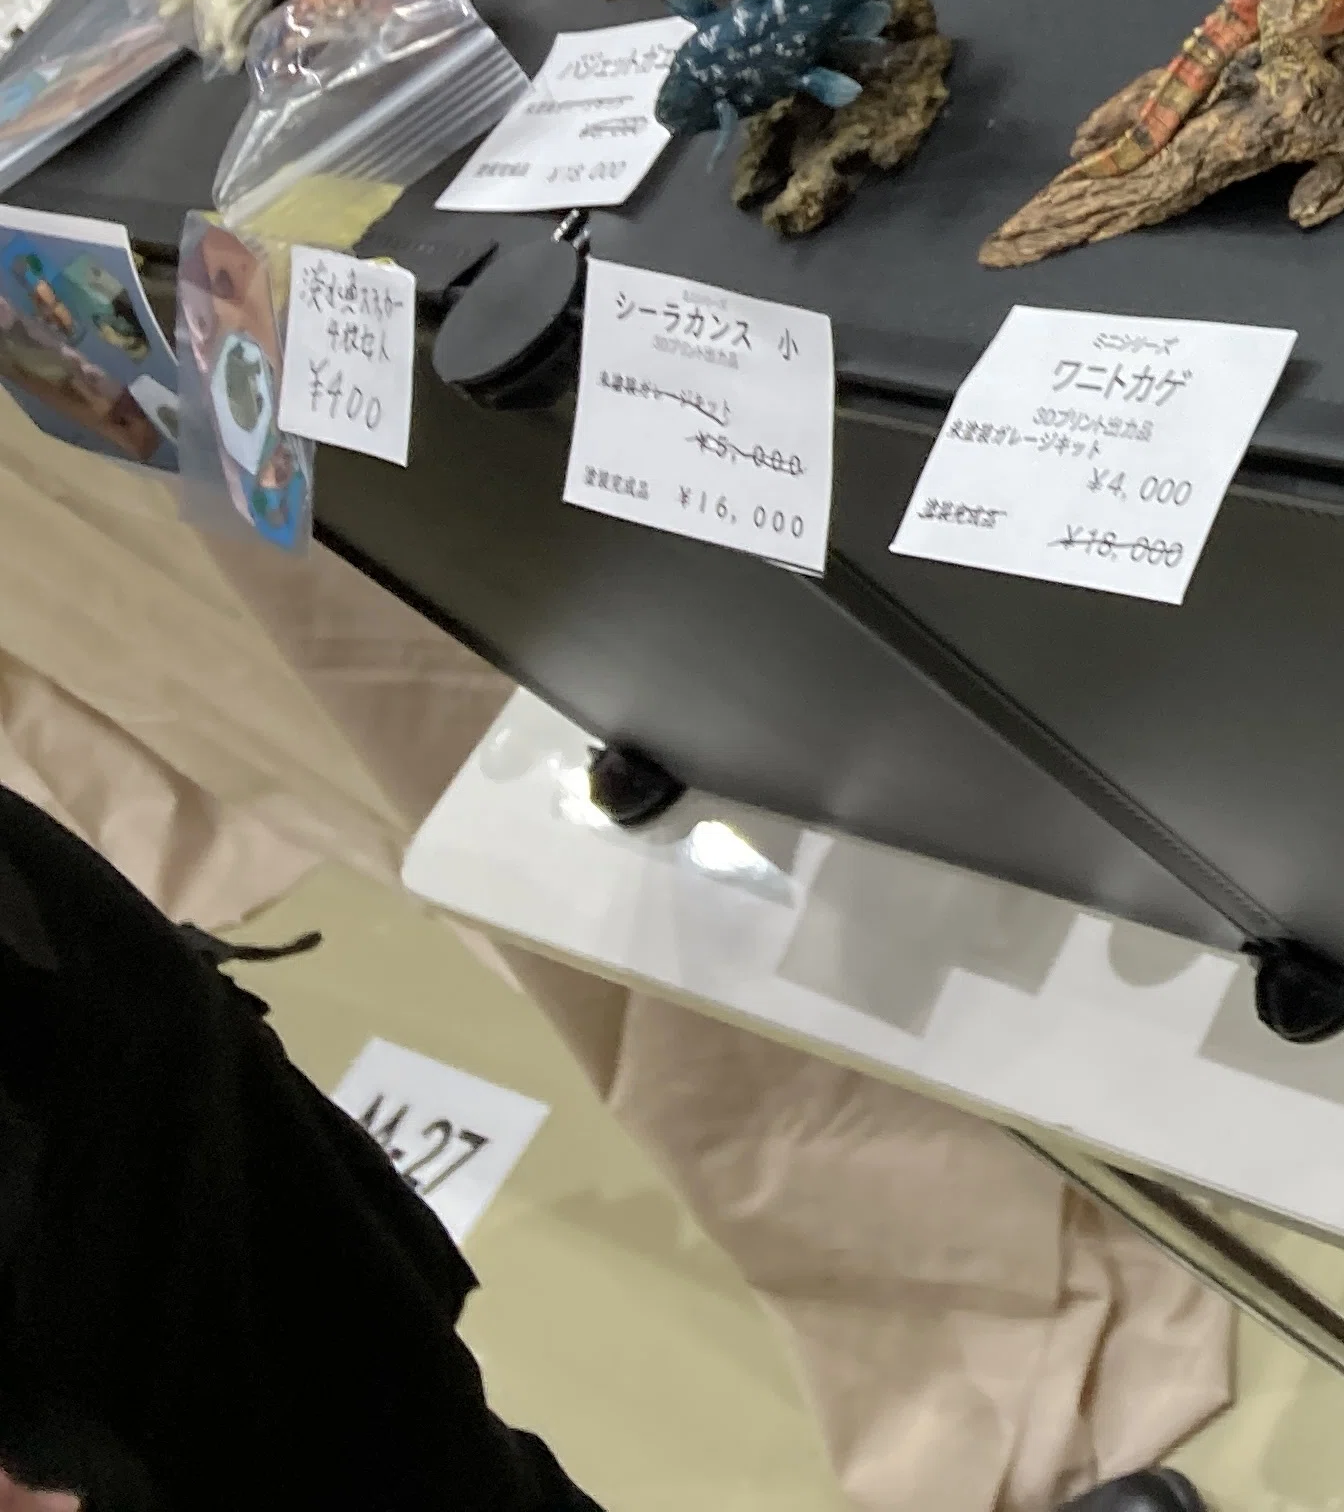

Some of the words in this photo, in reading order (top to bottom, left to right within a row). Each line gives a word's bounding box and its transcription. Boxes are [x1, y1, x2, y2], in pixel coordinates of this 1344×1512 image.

[615, 290, 752, 351] シーラカンス
[777, 327, 801, 361] 小
[308, 357, 383, 432] ¥400
[1051, 358, 1194, 407] ワニトカゲ
[678, 484, 805, 539] ¥16,000
[1086, 466, 1194, 507] ¥4,000
